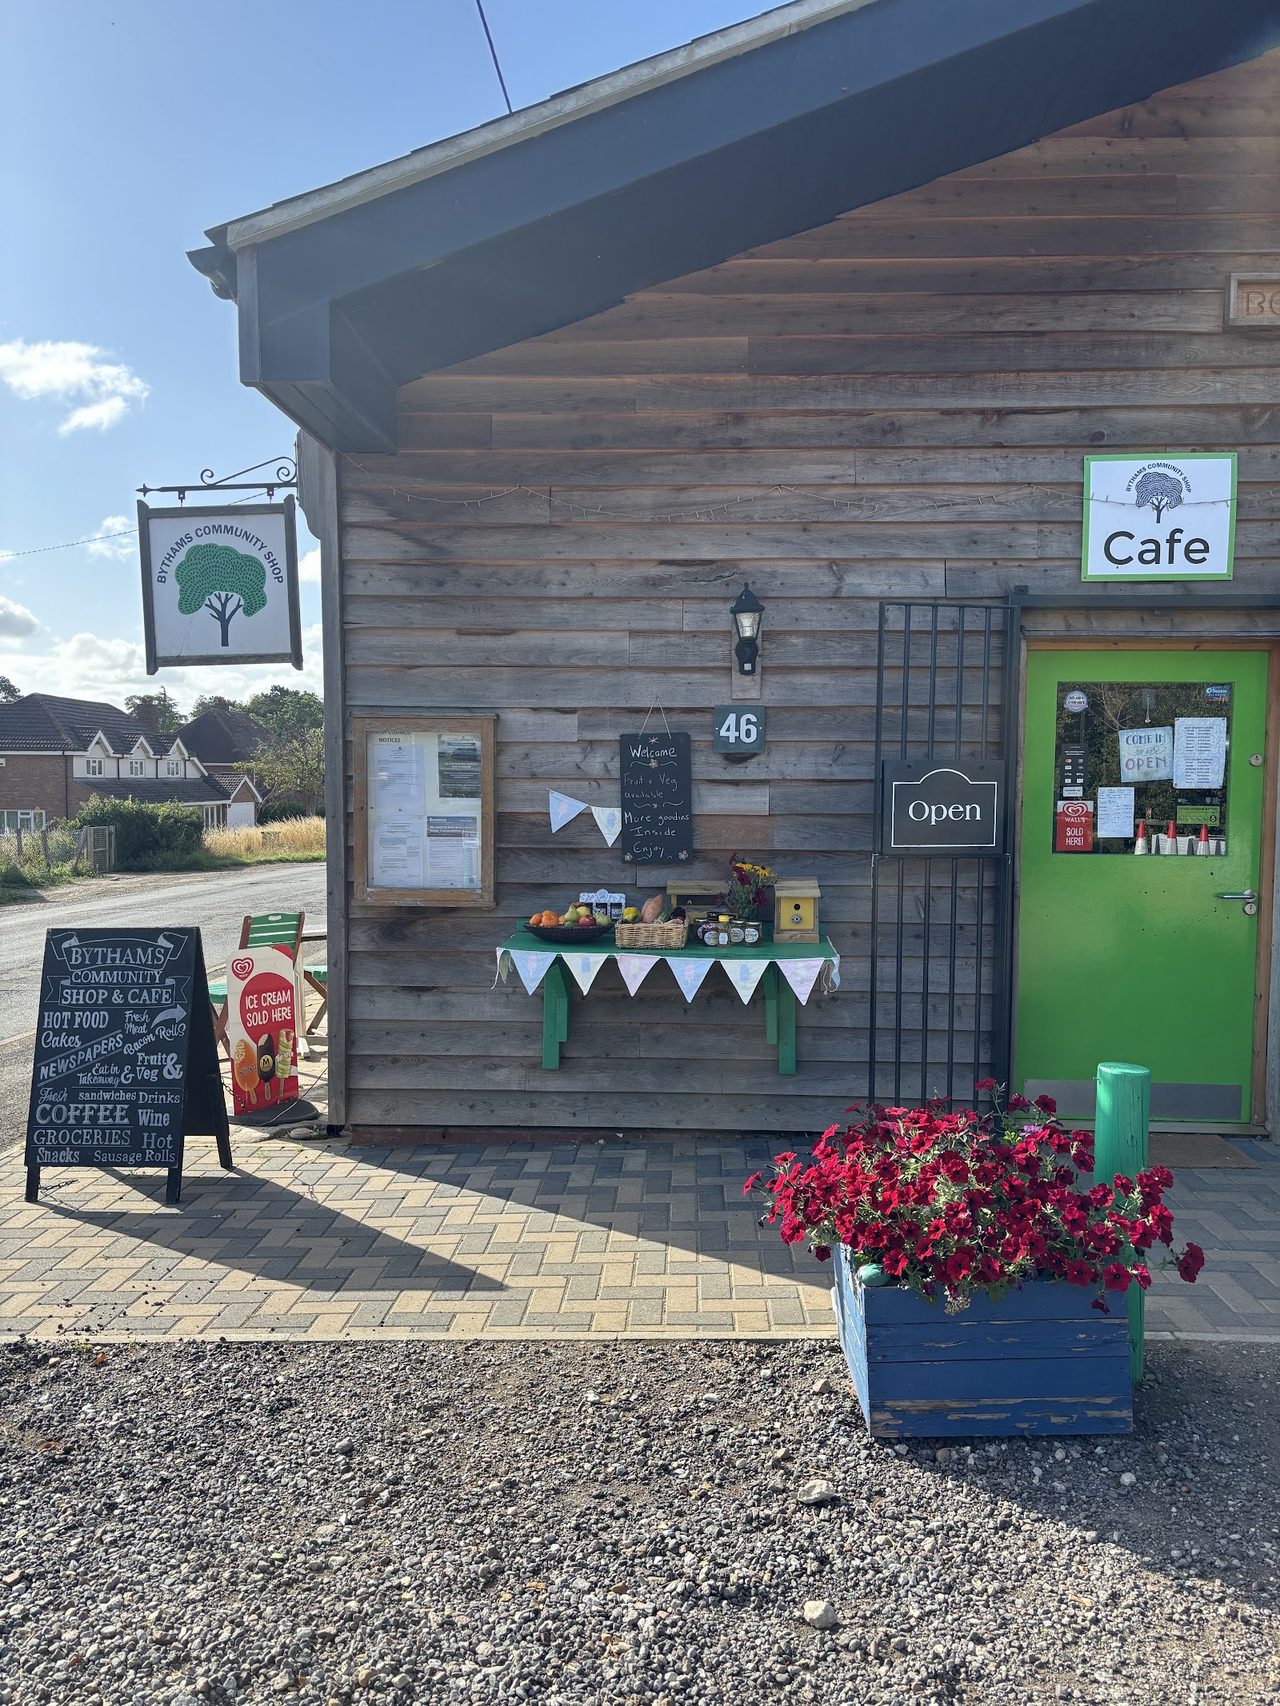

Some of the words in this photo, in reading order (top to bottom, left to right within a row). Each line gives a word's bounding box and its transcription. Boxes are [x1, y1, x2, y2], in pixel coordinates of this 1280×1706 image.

[1125, 466, 1147, 492] BYTHAMS
[1147, 462, 1184, 477] COMMUNITY
[1182, 476, 1192, 493] SHOP
[156, 532, 194, 584] BYTHAMS
[194, 524, 267, 552] COMMUNITY
[263, 551, 284, 584] SHOP
[1103, 528, 1210, 565] Cafe
[719, 713, 758, 744] 46
[1125, 734, 1152, 745] COME
[1155, 734, 1166, 743] IN
[629, 745, 677, 758] Welcome
[1125, 756, 1167, 770] OPEN
[624, 772, 643, 786] Fruit
[658, 773, 678, 792] Veg
[624, 790, 664, 799] available
[624, 811, 651, 825] More
[658, 812, 690, 826] goodies
[908, 800, 981, 826] Open
[630, 826, 676, 837] Inside
[1066, 827, 1084, 836] SOLD
[1065, 837, 1084, 846] HERE!
[632, 842, 664, 859] Enjoy
[70, 947, 165, 965] BYTHAMS
[71, 970, 163, 984] COMMUNITY
[61, 988, 108, 1004] SHOP
[112, 990, 124, 1004] &
[127, 988, 172, 1004] CAFE
[245, 994, 258, 1010] ICE
[261, 989, 291, 1007] CREAM
[43, 1011, 71, 1029] HOT
[73, 1010, 109, 1029] FOOD
[124, 1010, 150, 1023] Fresh
[246, 1010, 269, 1027] SOLD
[271, 1006, 292, 1023] HERE
[124, 1022, 148, 1035] Meat
[41, 1030, 82, 1048] Cakes
[123, 1033, 156, 1056] Bacon
[39, 1033, 124, 1080] NEWSPAPERS
[92, 1063, 110, 1076] Eat
[110, 1063, 120, 1075] in
[136, 1052, 167, 1066] Fruit
[162, 1053, 184, 1080] &
[136, 1067, 158, 1082] Veg
[77, 1072, 121, 1088] Takeaway
[121, 1065, 135, 1084] &
[38, 1087, 68, 1104] Fresh
[78, 1090, 137, 1101] sandwiches
[138, 1092, 181, 1104] Drinks
[35, 1103, 130, 1125] COFFEE
[137, 1108, 170, 1127] Wine
[33, 1129, 132, 1145] GROCERIES
[141, 1132, 173, 1149] Hot
[36, 1147, 80, 1163] Snacks
[93, 1149, 142, 1165] Sausage
[144, 1150, 176, 1162] Rolls
